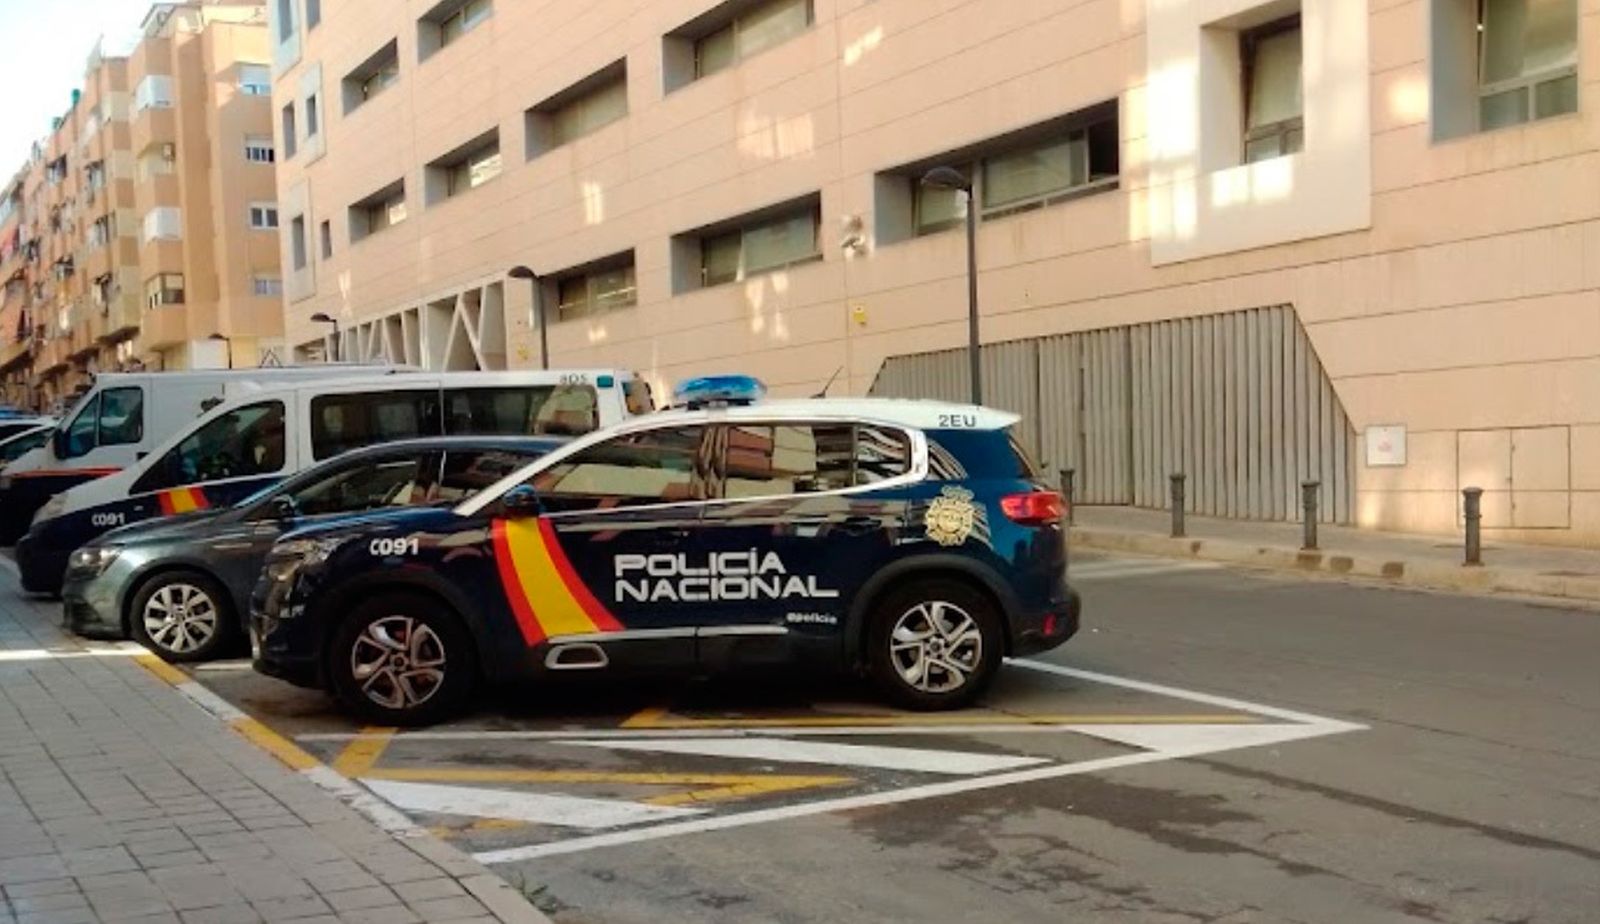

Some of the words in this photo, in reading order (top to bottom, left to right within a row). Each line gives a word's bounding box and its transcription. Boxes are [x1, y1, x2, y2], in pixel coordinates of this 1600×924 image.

[938, 414, 976, 428] 2EU
[614, 547, 786, 577] POLICÍA
[615, 575, 839, 602] NACIONAL
